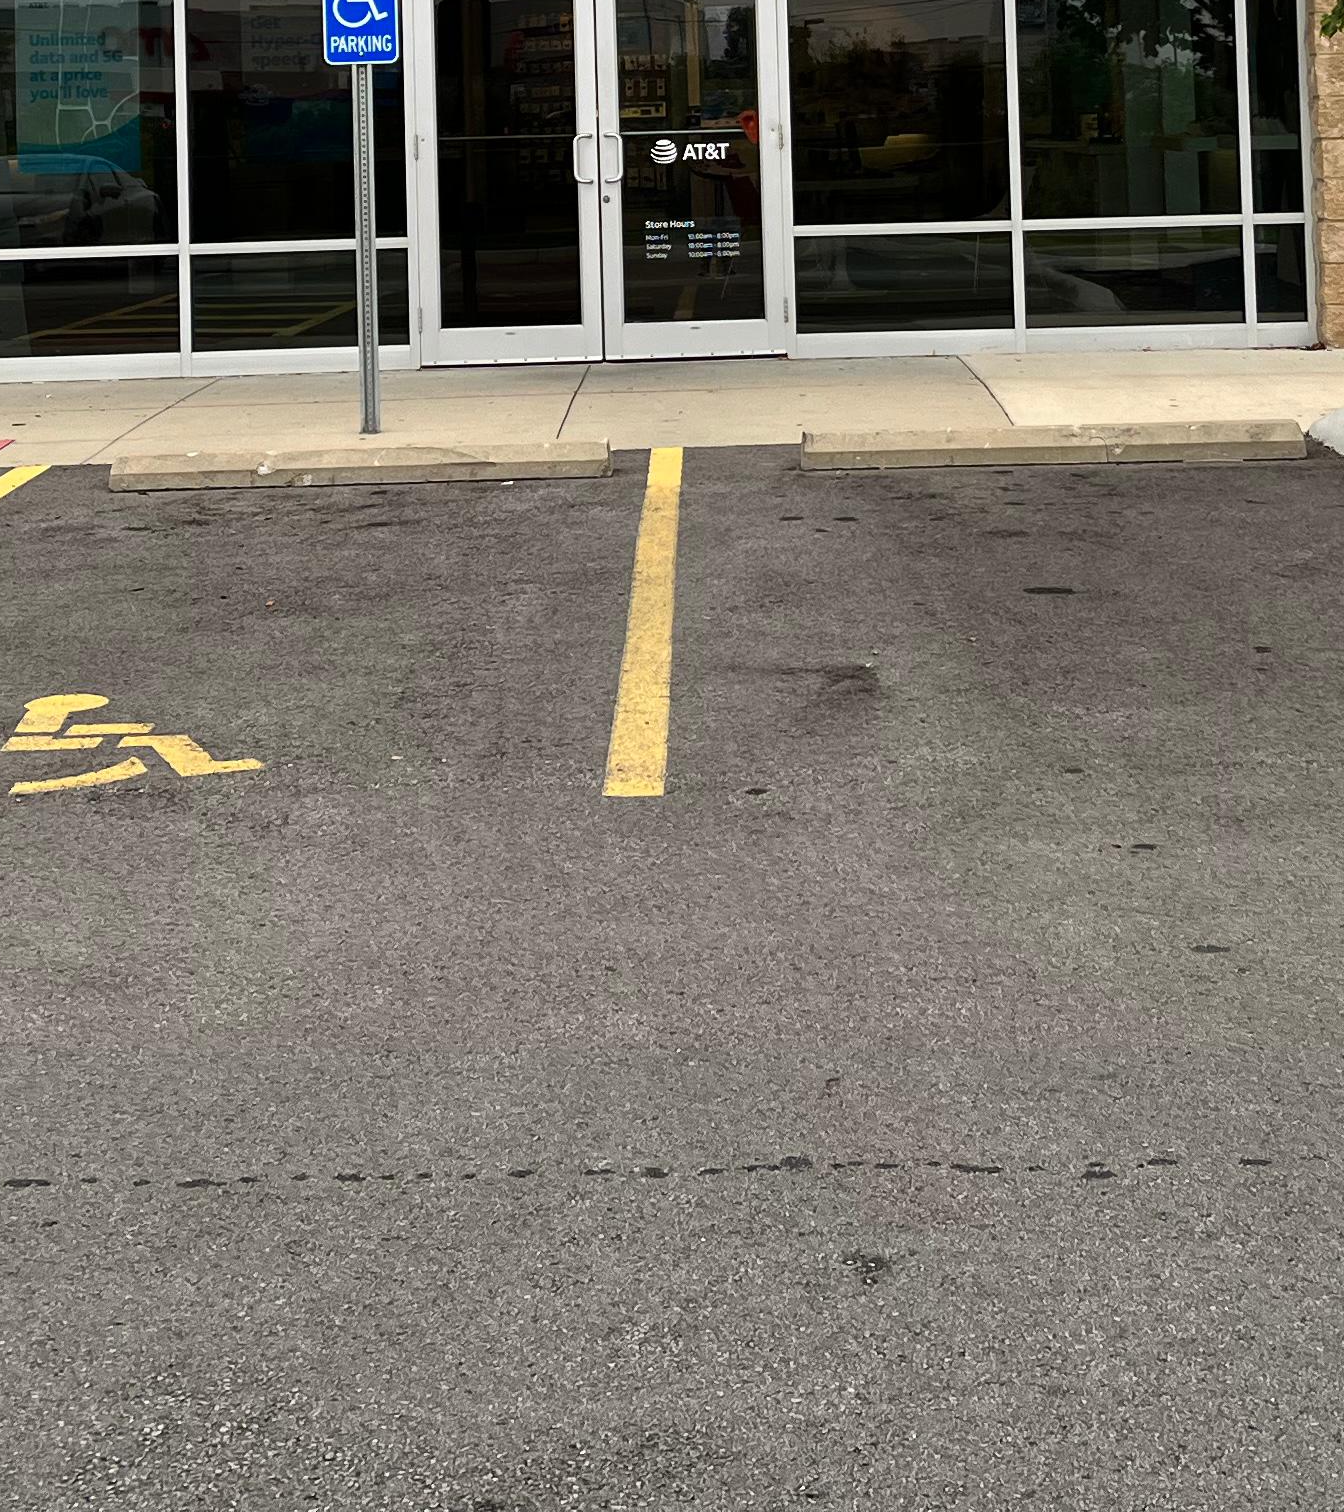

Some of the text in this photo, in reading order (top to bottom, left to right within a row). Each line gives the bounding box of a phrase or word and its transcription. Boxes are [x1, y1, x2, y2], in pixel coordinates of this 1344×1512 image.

[30, 32, 106, 46] Unlimited
[330, 34, 393, 54] PARKING
[30, 49, 124, 64] data and 5G
[30, 71, 47, 82] at
[64, 69, 103, 85] price
[77, 85, 109, 99] love
[682, 142, 730, 161] AT&T
[645, 219, 695, 229] Store Hours
